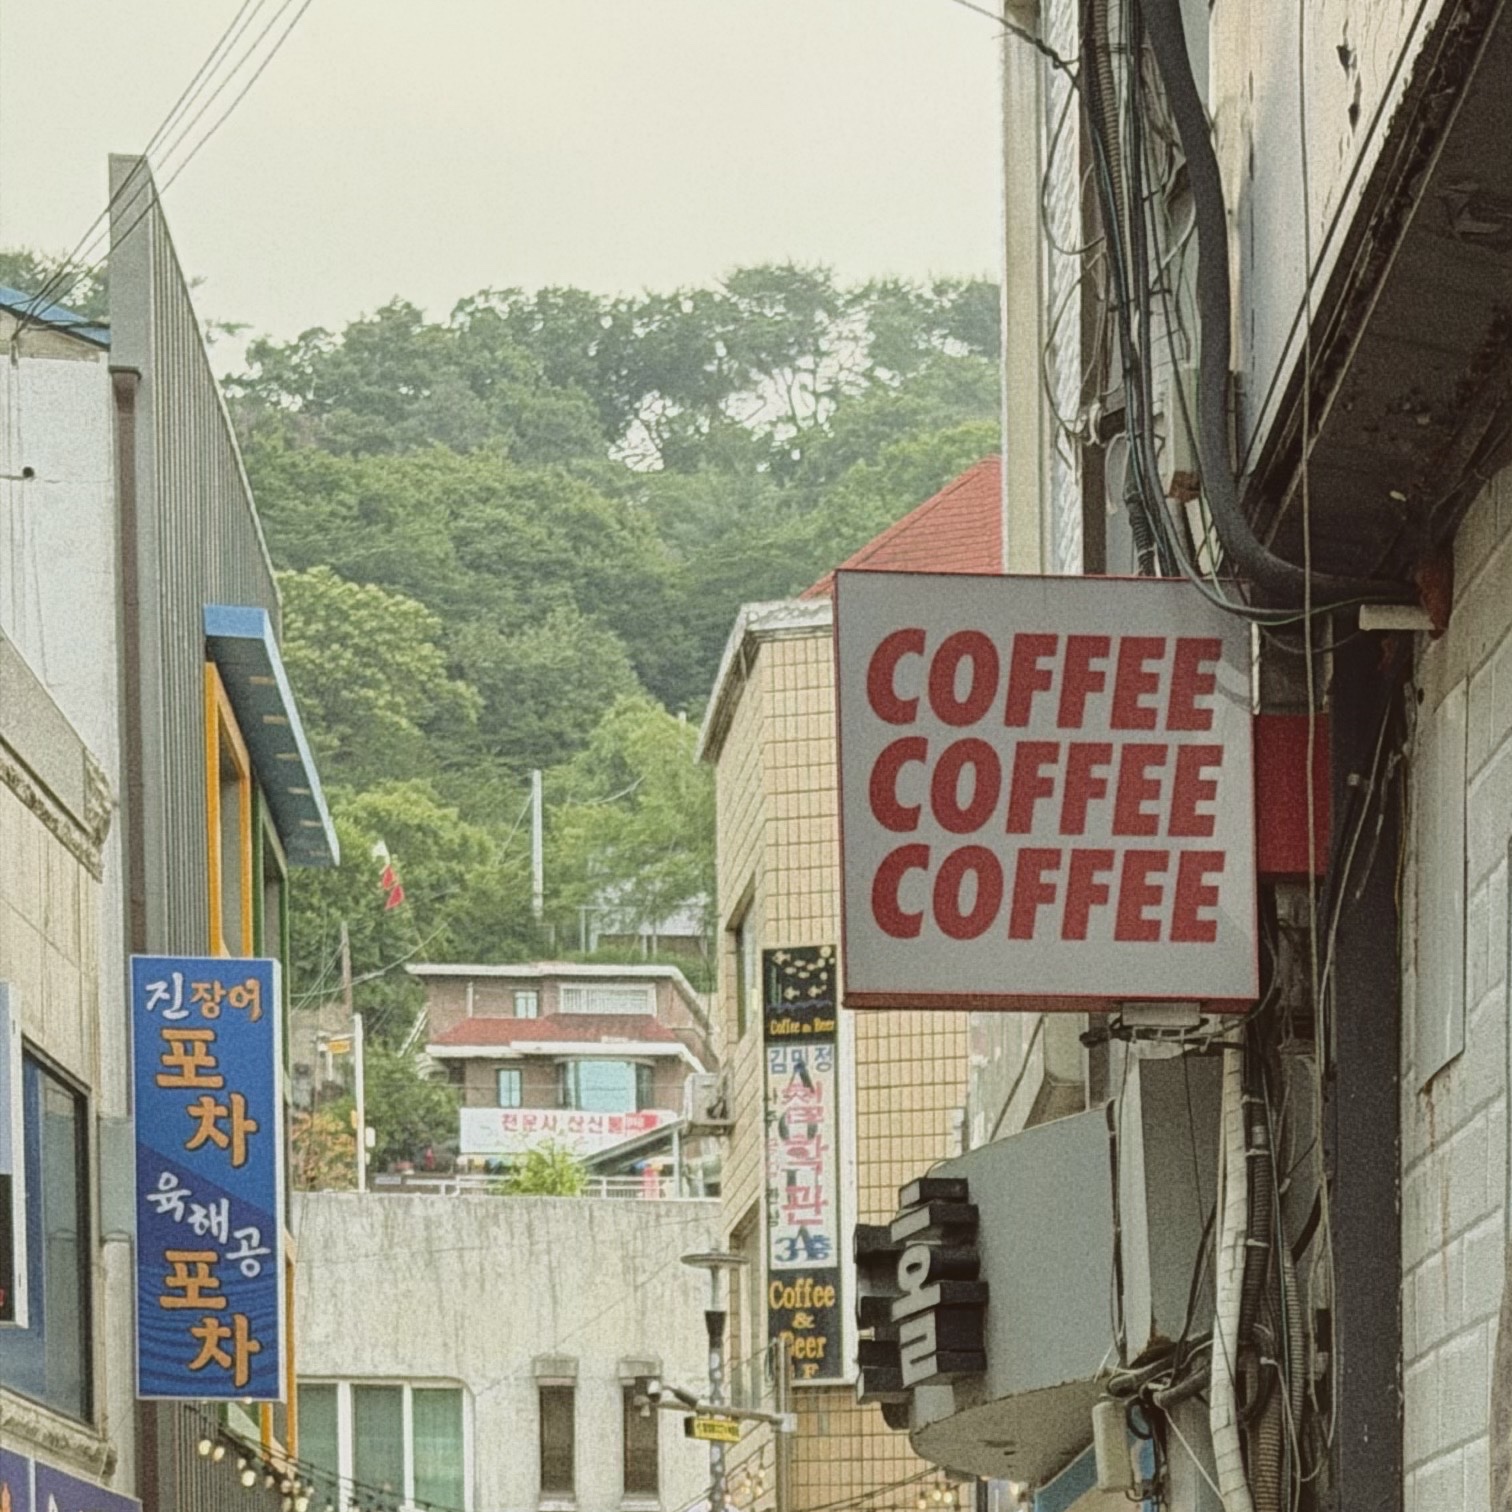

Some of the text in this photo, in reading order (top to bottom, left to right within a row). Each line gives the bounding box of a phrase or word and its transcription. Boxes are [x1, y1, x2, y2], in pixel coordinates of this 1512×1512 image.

[866, 628, 1223, 731] COFFEE
[869, 736, 1224, 837] COFFEE
[871, 843, 1226, 942] COFFEE
[145, 973, 263, 1022] 진장어
[155, 1028, 259, 1168] 포차
[147, 1171, 271, 1278] 육해공
[159, 1249, 261, 1388] 포차
[769, 1277, 836, 1310] Coffee
[792, 1312, 815, 1329] &
[779, 1329, 827, 1359] Beer
